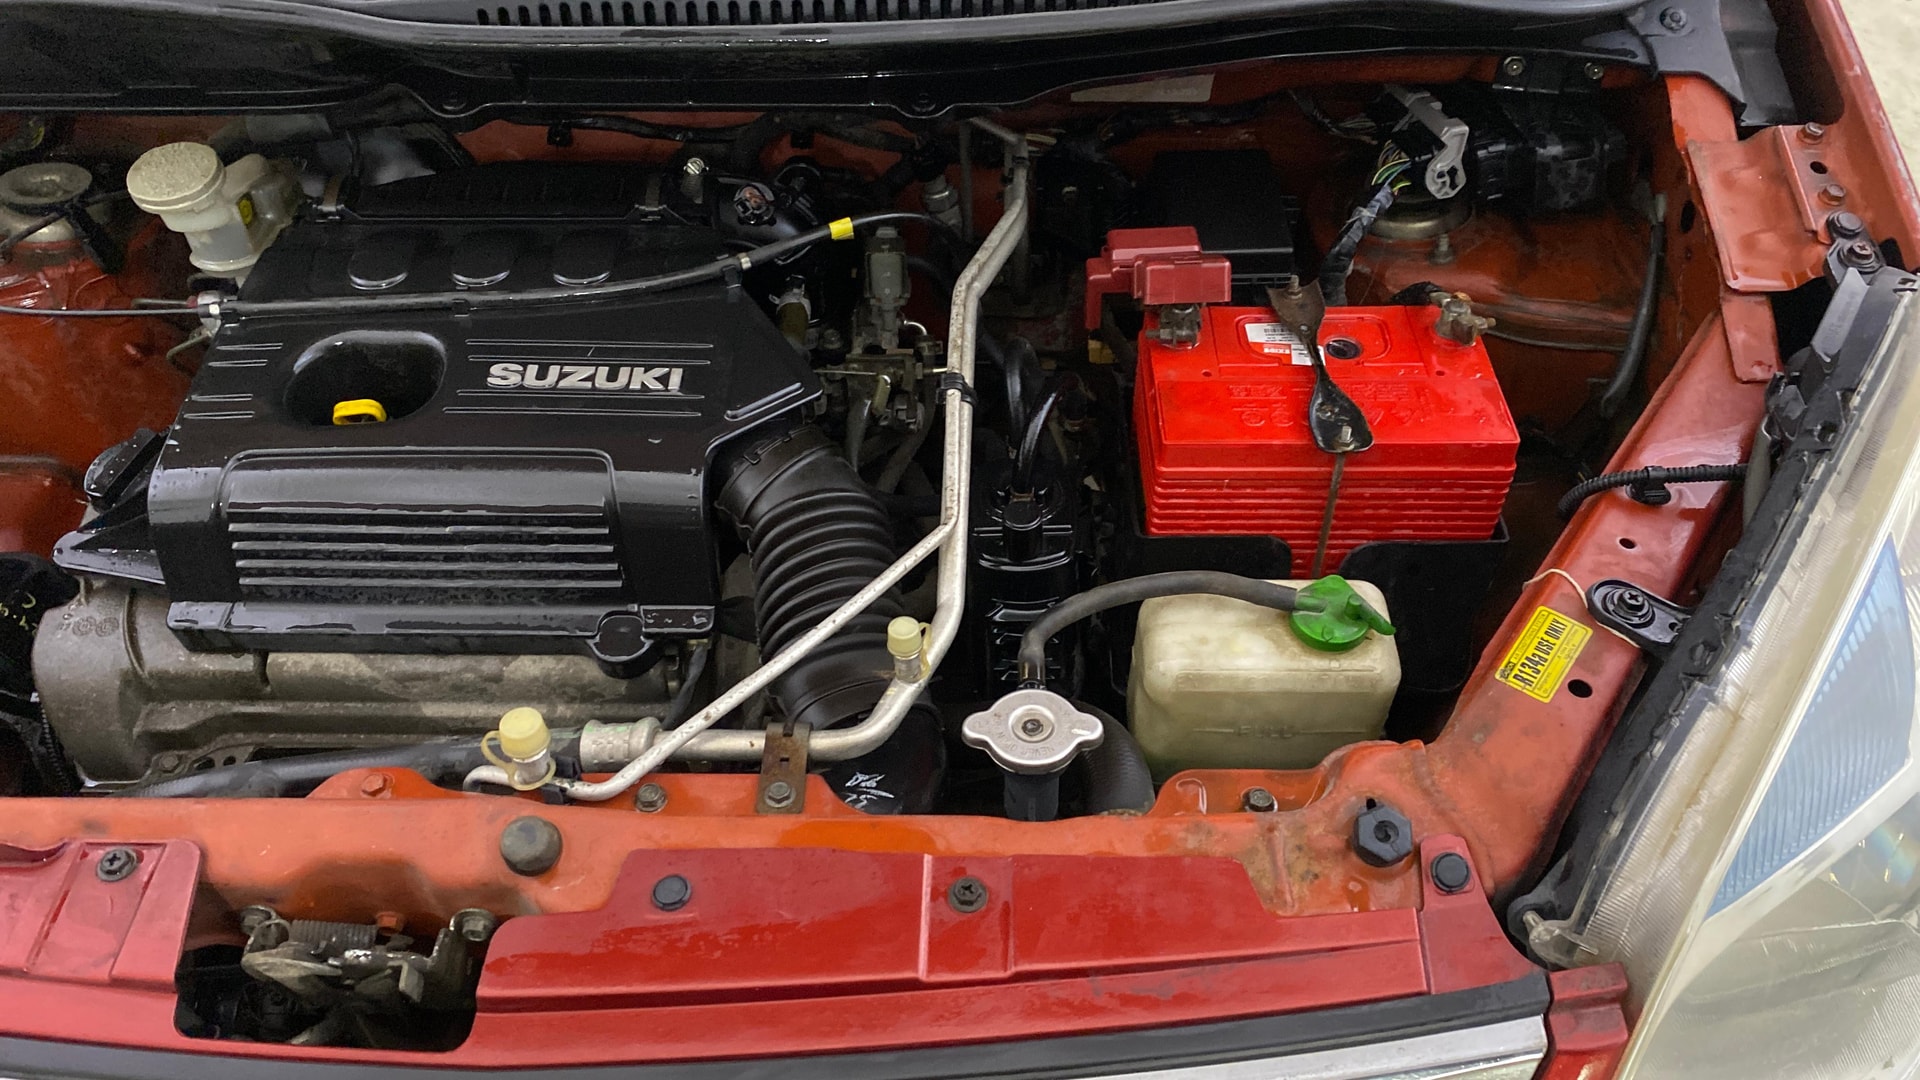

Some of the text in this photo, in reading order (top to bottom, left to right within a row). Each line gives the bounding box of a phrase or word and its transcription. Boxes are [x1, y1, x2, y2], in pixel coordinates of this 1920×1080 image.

[486, 363, 684, 390] SUZUKI
[1543, 617, 1568, 641] ONLY
[1533, 636, 1556, 656] USE
[1512, 651, 1548, 687] R134a
